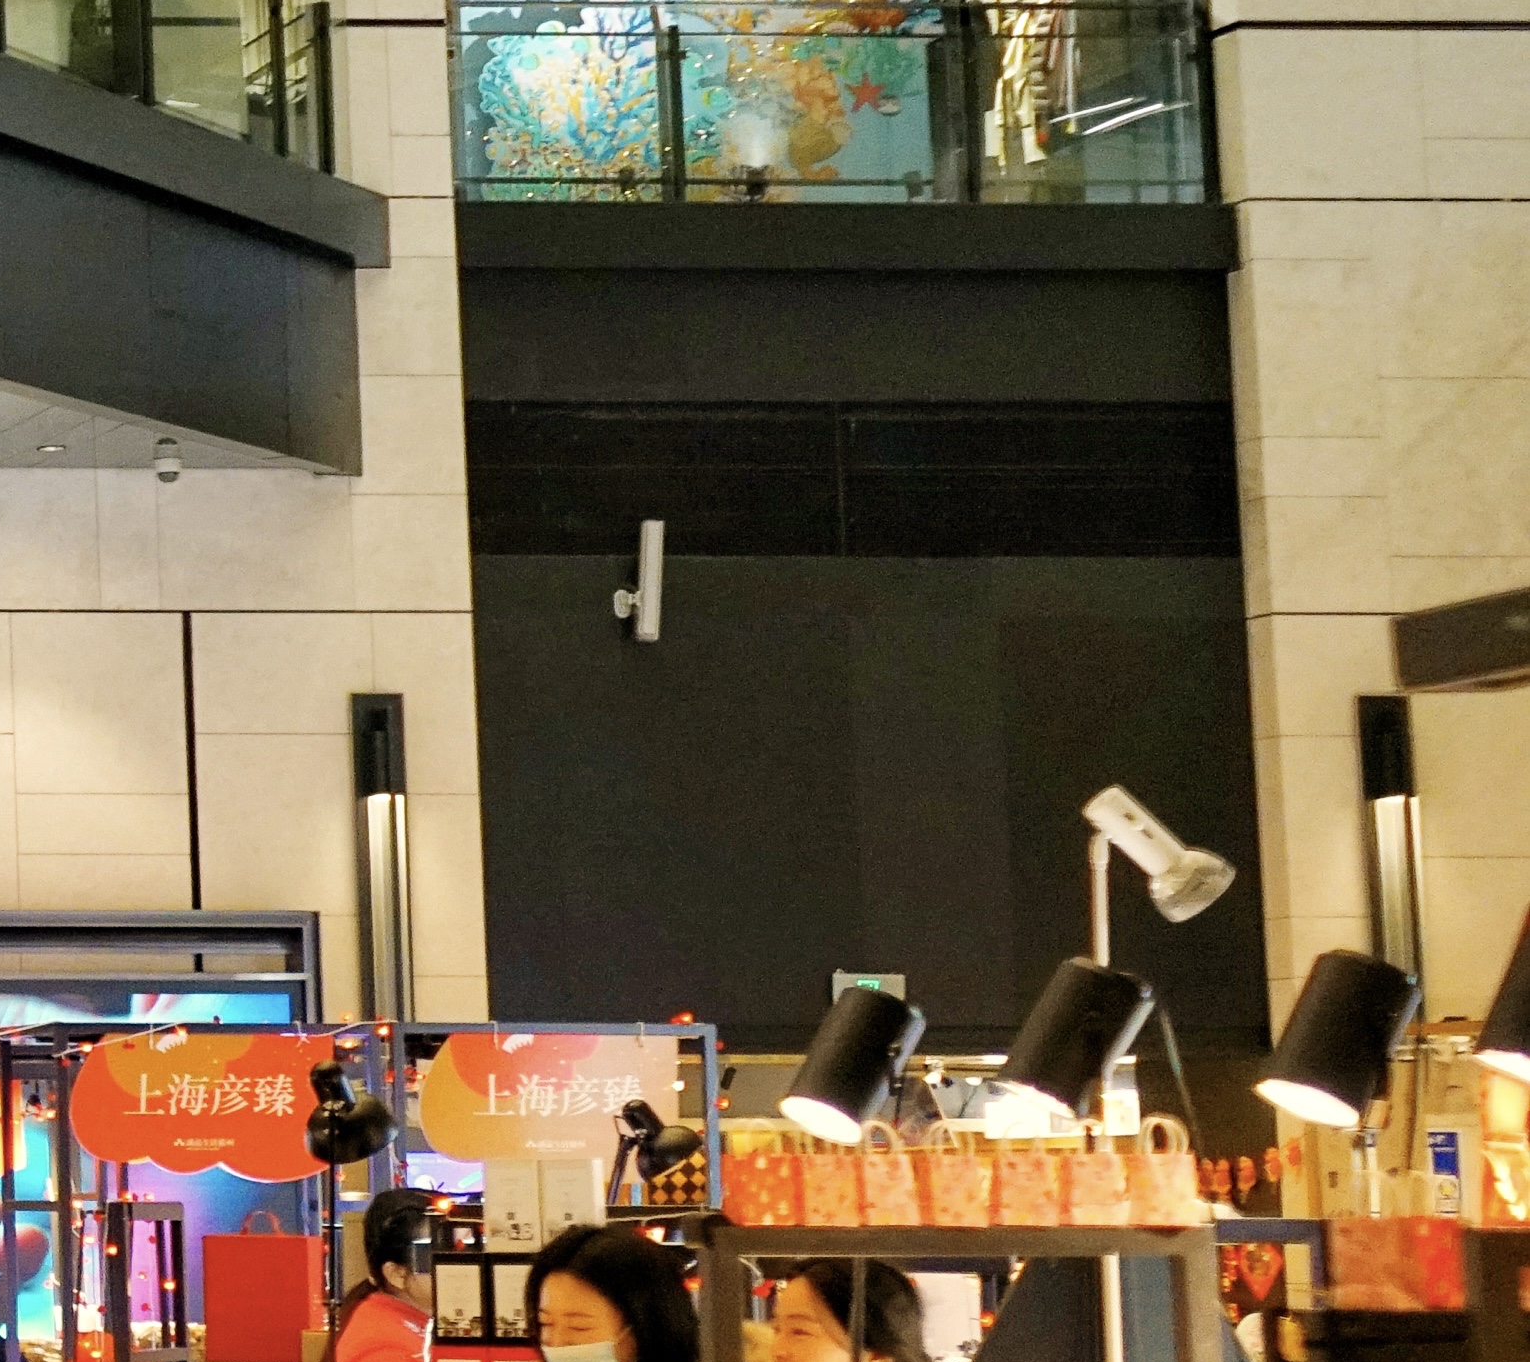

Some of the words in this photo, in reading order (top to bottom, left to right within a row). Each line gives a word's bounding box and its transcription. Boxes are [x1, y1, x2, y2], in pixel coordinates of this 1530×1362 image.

[123, 1072, 297, 1119] 上海彦臻
[472, 1072, 648, 1117] 上海彦臻
